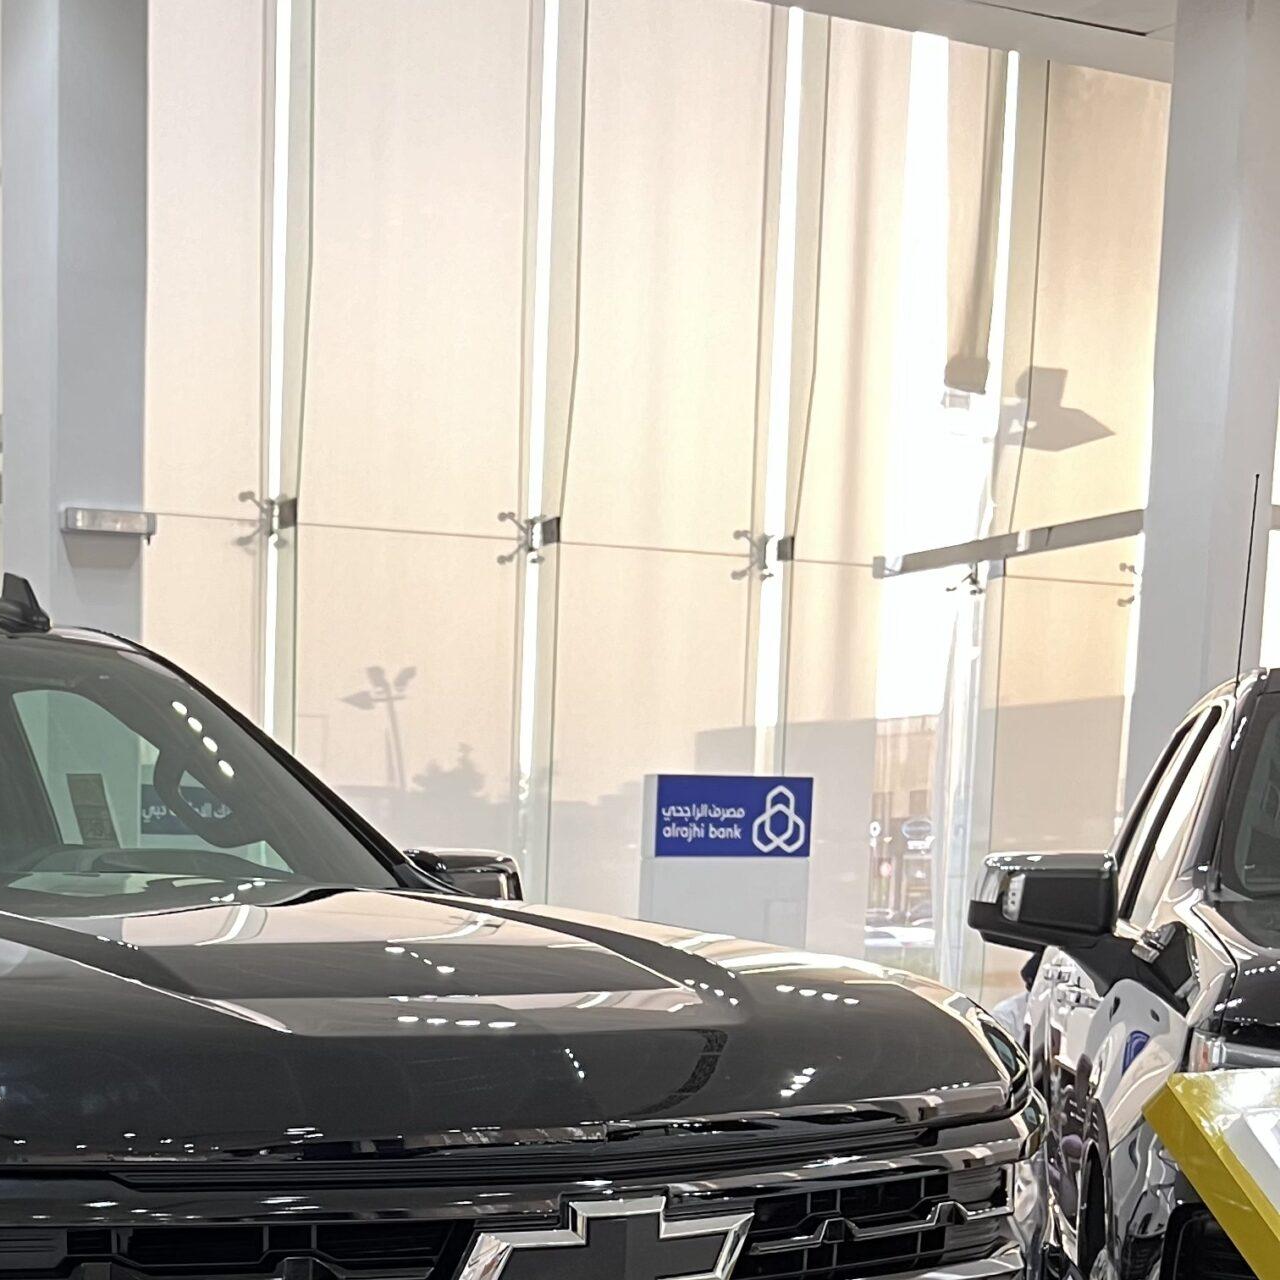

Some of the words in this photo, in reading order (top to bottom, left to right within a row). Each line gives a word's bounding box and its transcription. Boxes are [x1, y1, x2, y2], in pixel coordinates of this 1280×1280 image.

[661, 803, 708, 821] الراجحي
[708, 804, 745, 821] مصرف
[662, 822, 705, 842] alrajhi
[708, 823, 741, 839] bank
